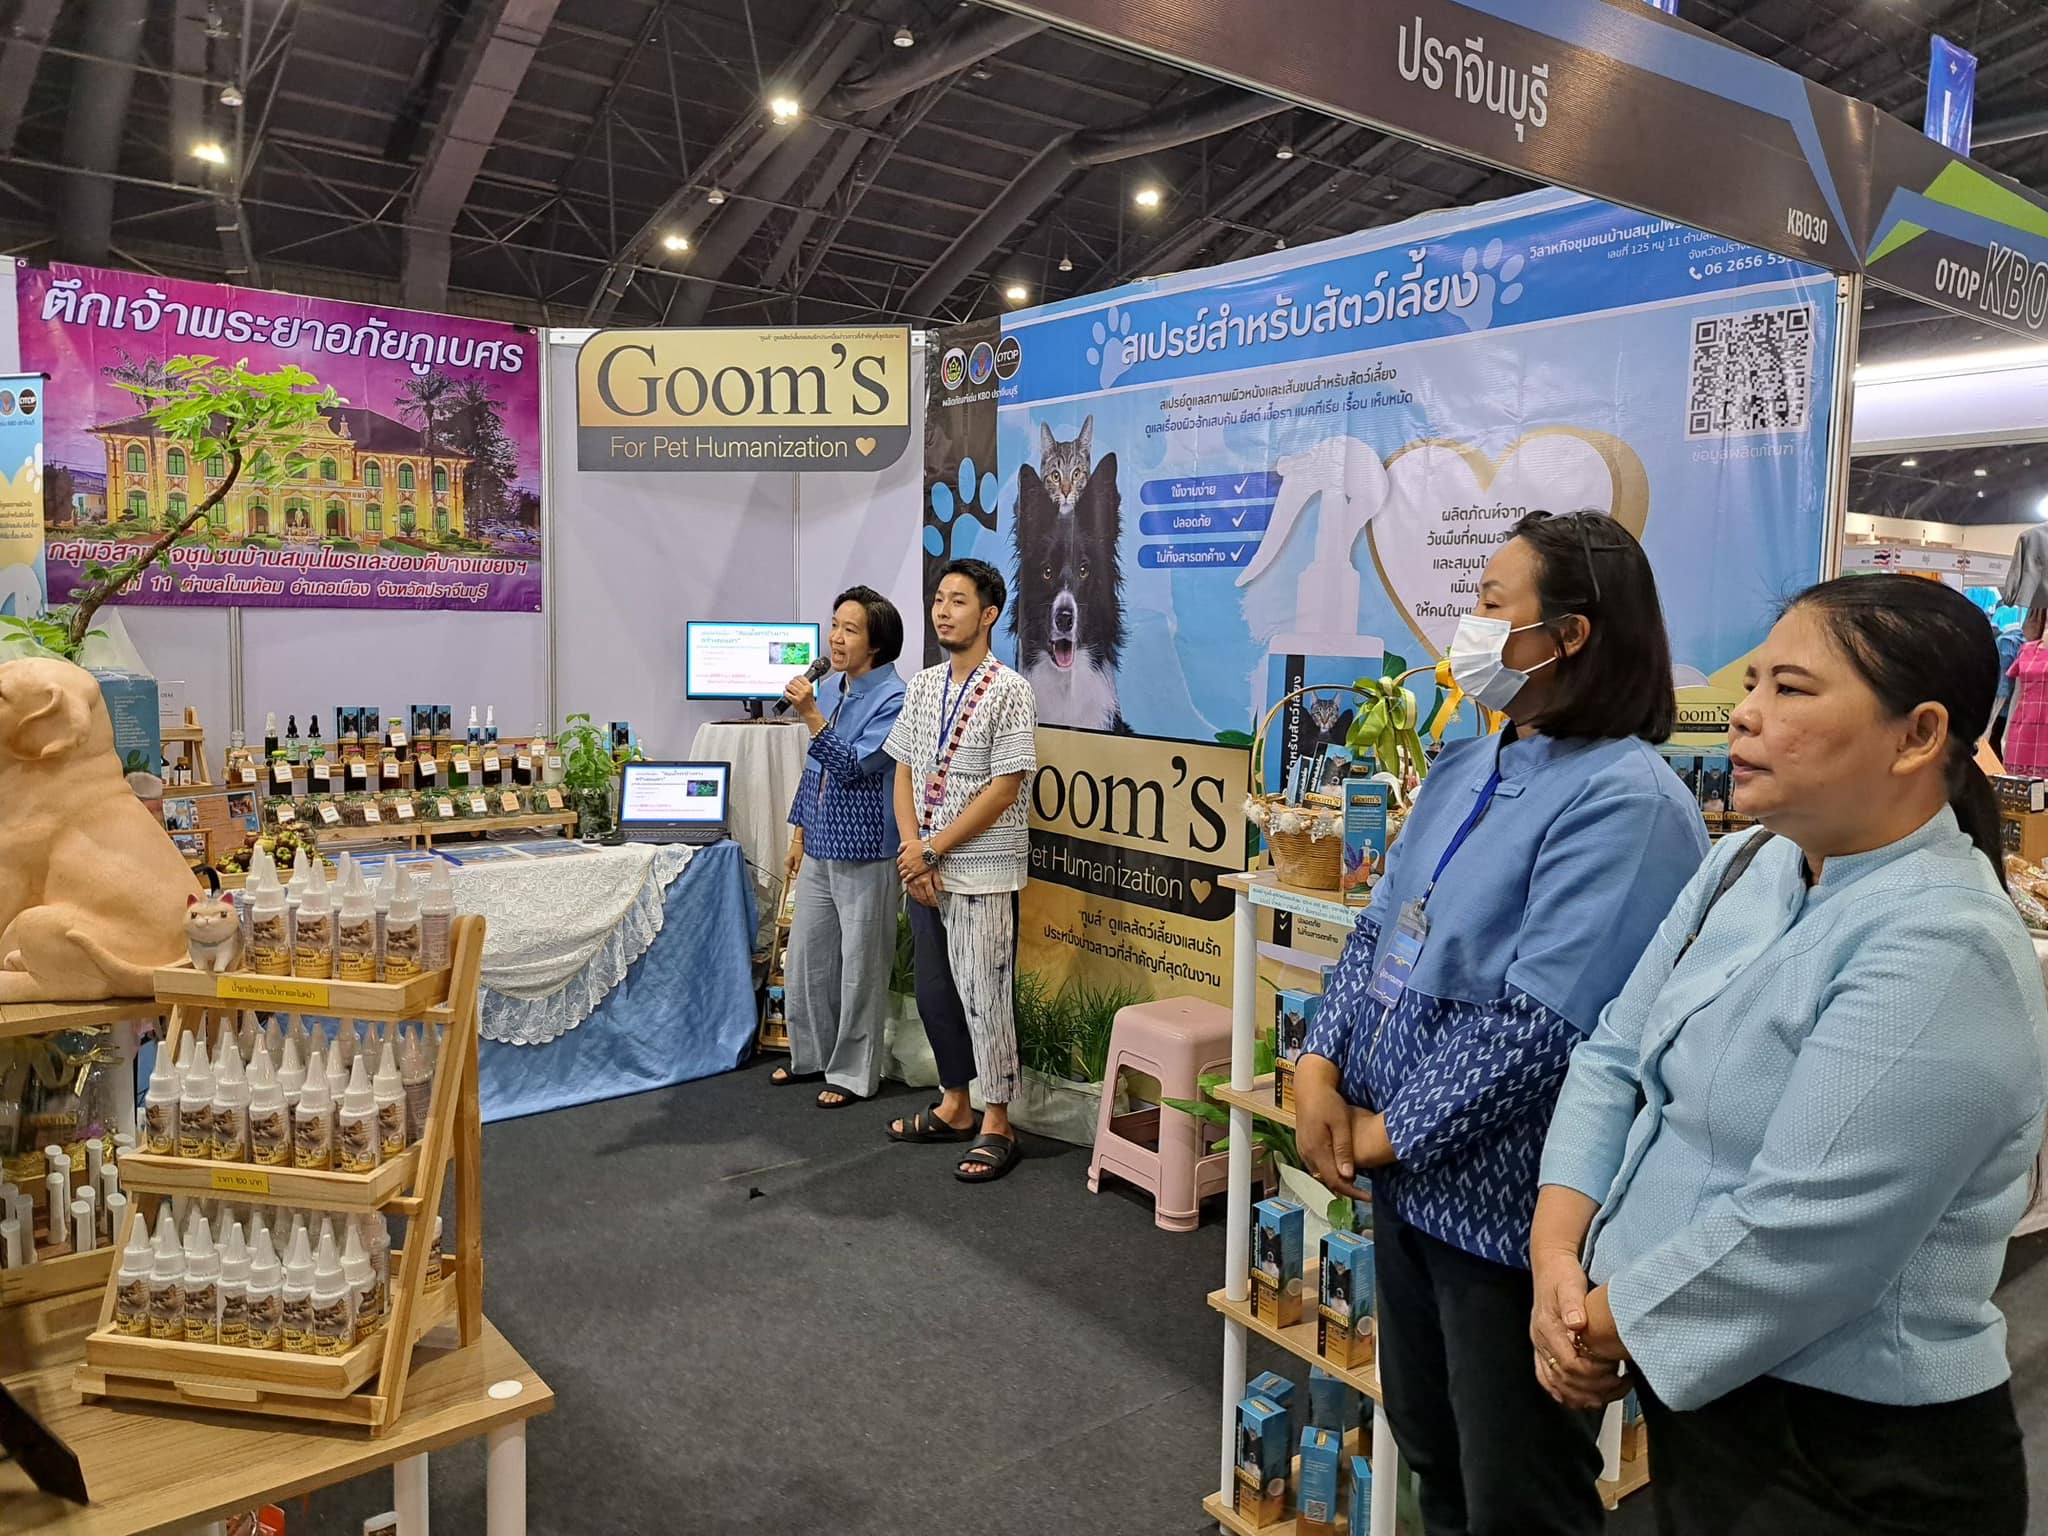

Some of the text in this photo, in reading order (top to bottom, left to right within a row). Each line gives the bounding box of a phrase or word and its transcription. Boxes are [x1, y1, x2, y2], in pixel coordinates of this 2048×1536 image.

[1397, 15, 1550, 143] ปราจีนบุรี
[1631, 244, 1649, 255] 125
[1652, 238, 1665, 252] หมู่
[1668, 235, 1680, 247] 11
[1704, 262, 1723, 276] 06
[1726, 254, 1763, 272] 2656
[1935, 240, 2048, 330] OTOP KBO
[1121, 247, 1480, 366] สเปรย์สำหรับสัตว์เลี้ยง
[40, 277, 526, 377] ตึกเจ้าพระยาอภัยภูเบศร
[997, 349, 1019, 364] OTOP
[597, 342, 890, 418] Goom's
[1263, 402, 1293, 421] เชื้อรา
[1295, 399, 1340, 417] แบคทีเรีย
[610, 434, 848, 458] For Pet Humanization
[1171, 481, 1217, 498] ใช้งานง่าย
[1173, 513, 1212, 529] ปลอดภัย
[1441, 502, 1527, 521] ผลิตภัณฑ์จาก
[1426, 524, 1506, 546] วัชพืชที่คนมอ
[1156, 545, 1226, 563] ไม่ทิ้งสารตกค้าง
[1432, 554, 1488, 575] และสมุนไ
[290, 578, 371, 597] อำเภอเมือง
[377, 580, 489, 603] จังหวัดปราจีนบุรี
[1679, 701, 1730, 722] oom's
[1032, 756, 1227, 854] oom's
[1052, 845, 1183, 901] Humanization
[1109, 917, 1221, 957] ดูแลสัตว์เลี้ยงแสนรัก
